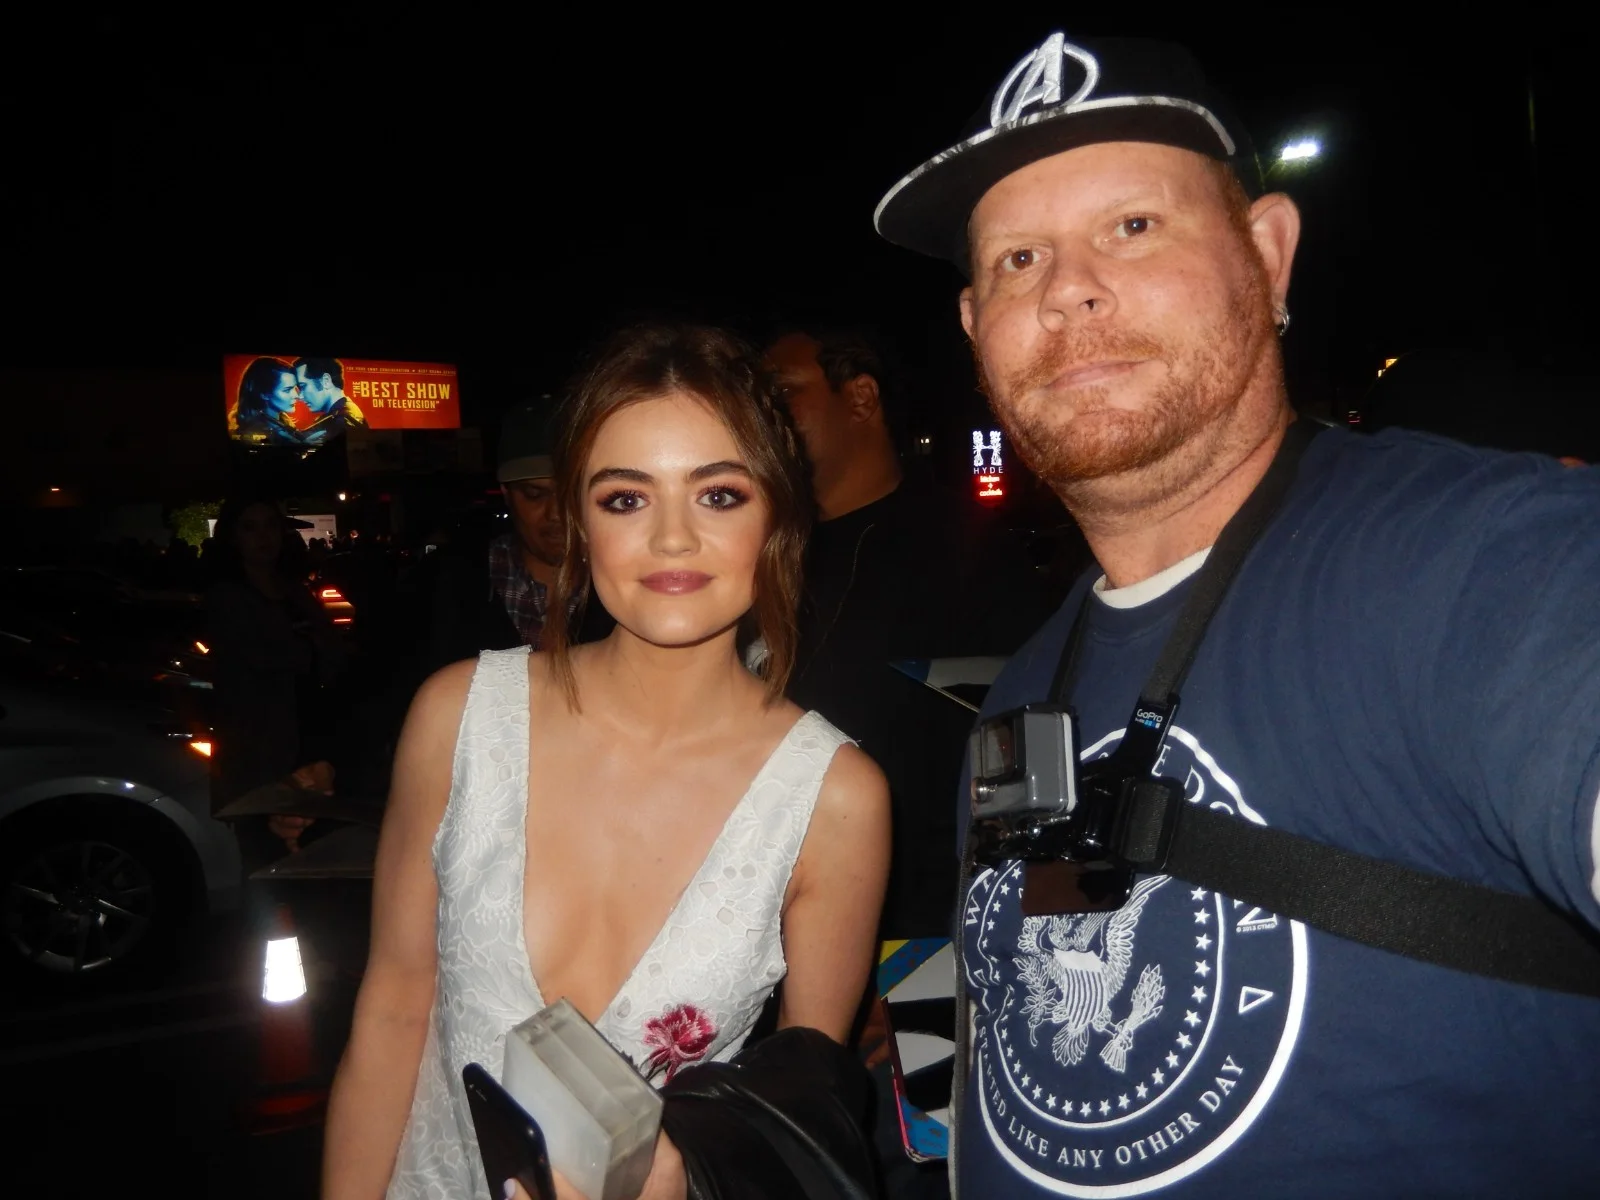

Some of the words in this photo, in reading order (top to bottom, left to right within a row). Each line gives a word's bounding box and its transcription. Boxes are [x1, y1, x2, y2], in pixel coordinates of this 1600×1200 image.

[360, 381, 399, 398] BEST
[406, 382, 450, 400] SHOW
[372, 398, 384, 408] ON
[973, 466, 1004, 475] HYDE
[1136, 708, 1163, 723] GoPro
[1008, 1116, 1049, 1157] LIKE
[1057, 1148, 1104, 1168] ANY
[1115, 1111, 1201, 1166] OTHER
[1199, 1055, 1245, 1113] DAY
